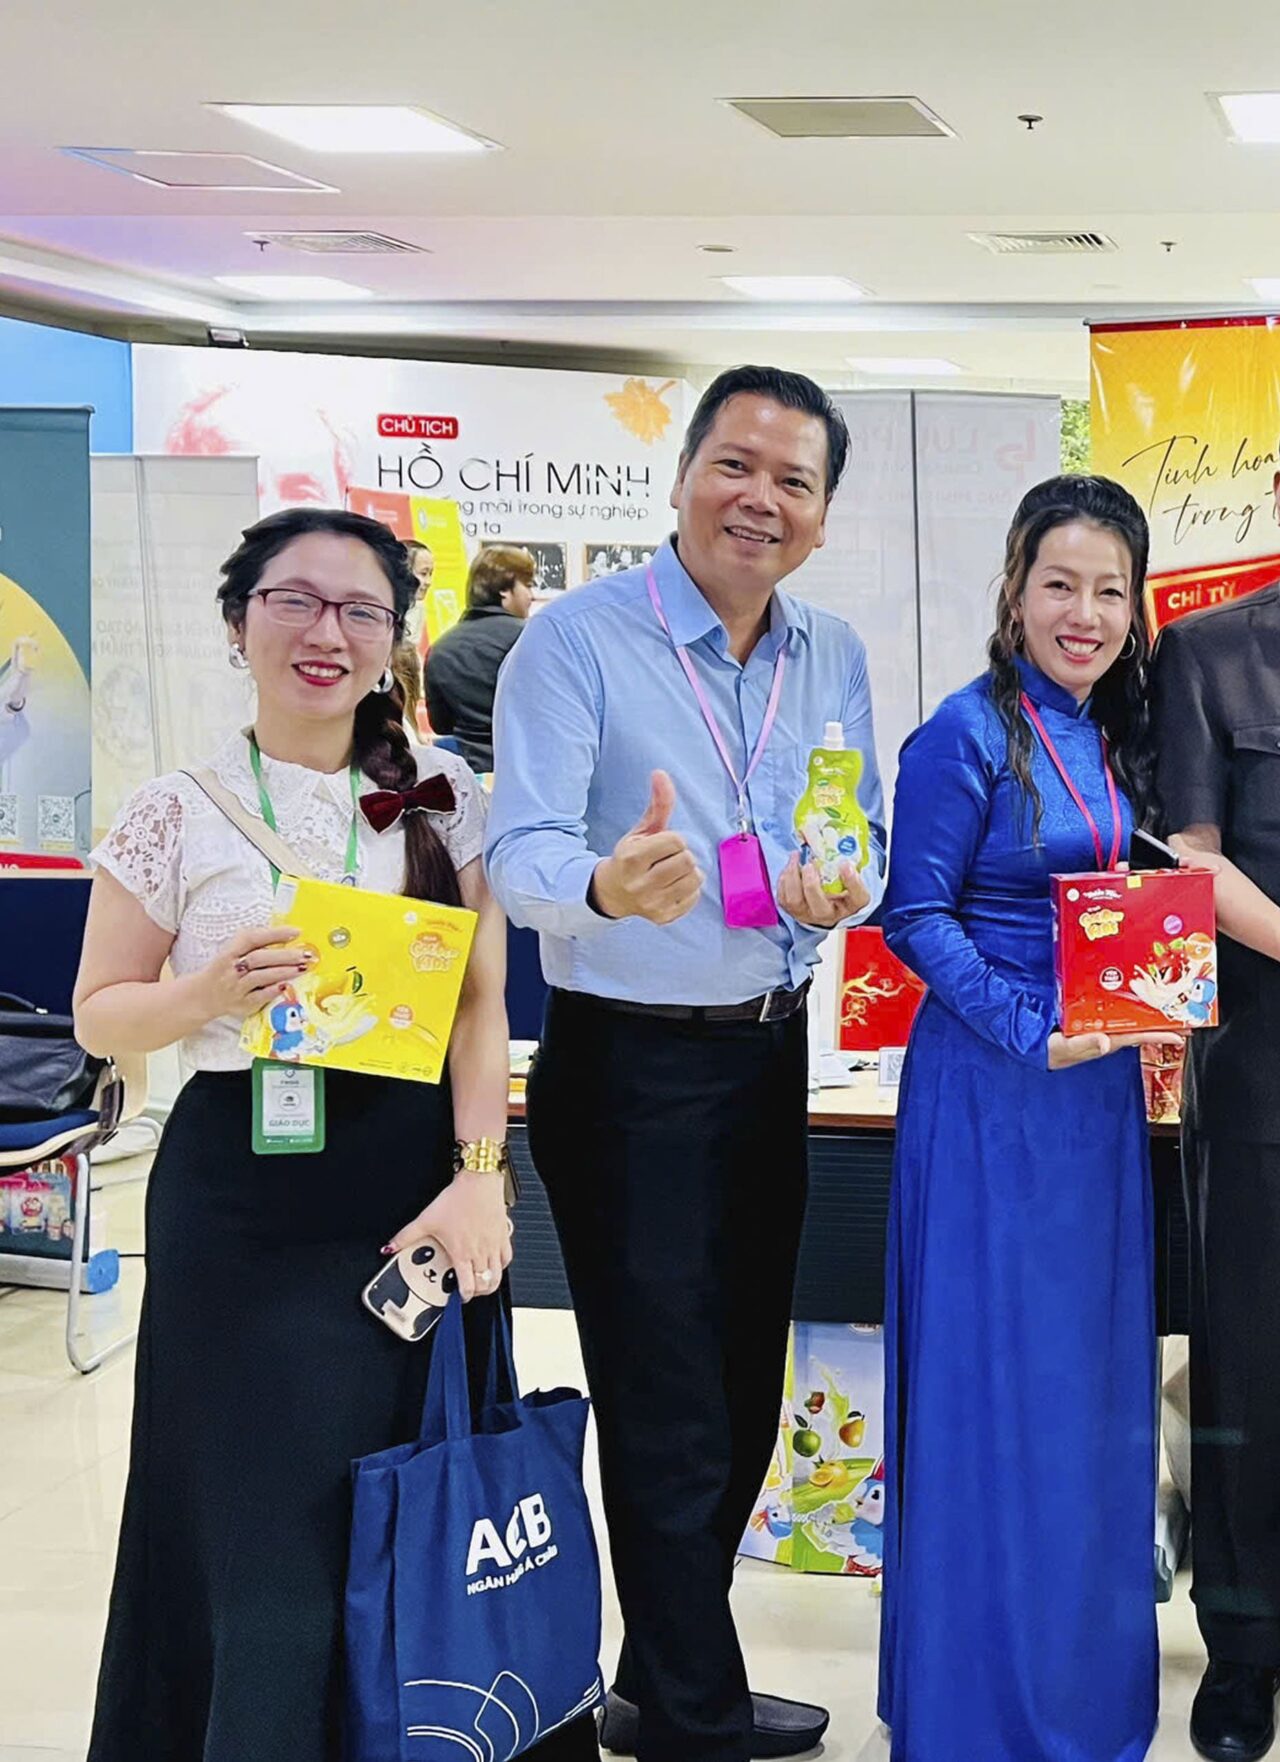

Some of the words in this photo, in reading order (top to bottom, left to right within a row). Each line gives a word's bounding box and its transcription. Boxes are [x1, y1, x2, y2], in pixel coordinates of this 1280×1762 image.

[381, 415, 416, 433] CHỦ
[419, 419, 453, 436] TỊCH
[378, 441, 444, 489] HỒ
[459, 452, 534, 493] CHÍ
[547, 461, 650, 498] MINH
[567, 502, 586, 519] sự
[590, 503, 650, 520] nghiệp
[484, 519, 502, 535] ta
[1167, 583, 1202, 609] CHỈ
[465, 1493, 552, 1576] ACB
[466, 1576, 504, 1596] NGÂN
